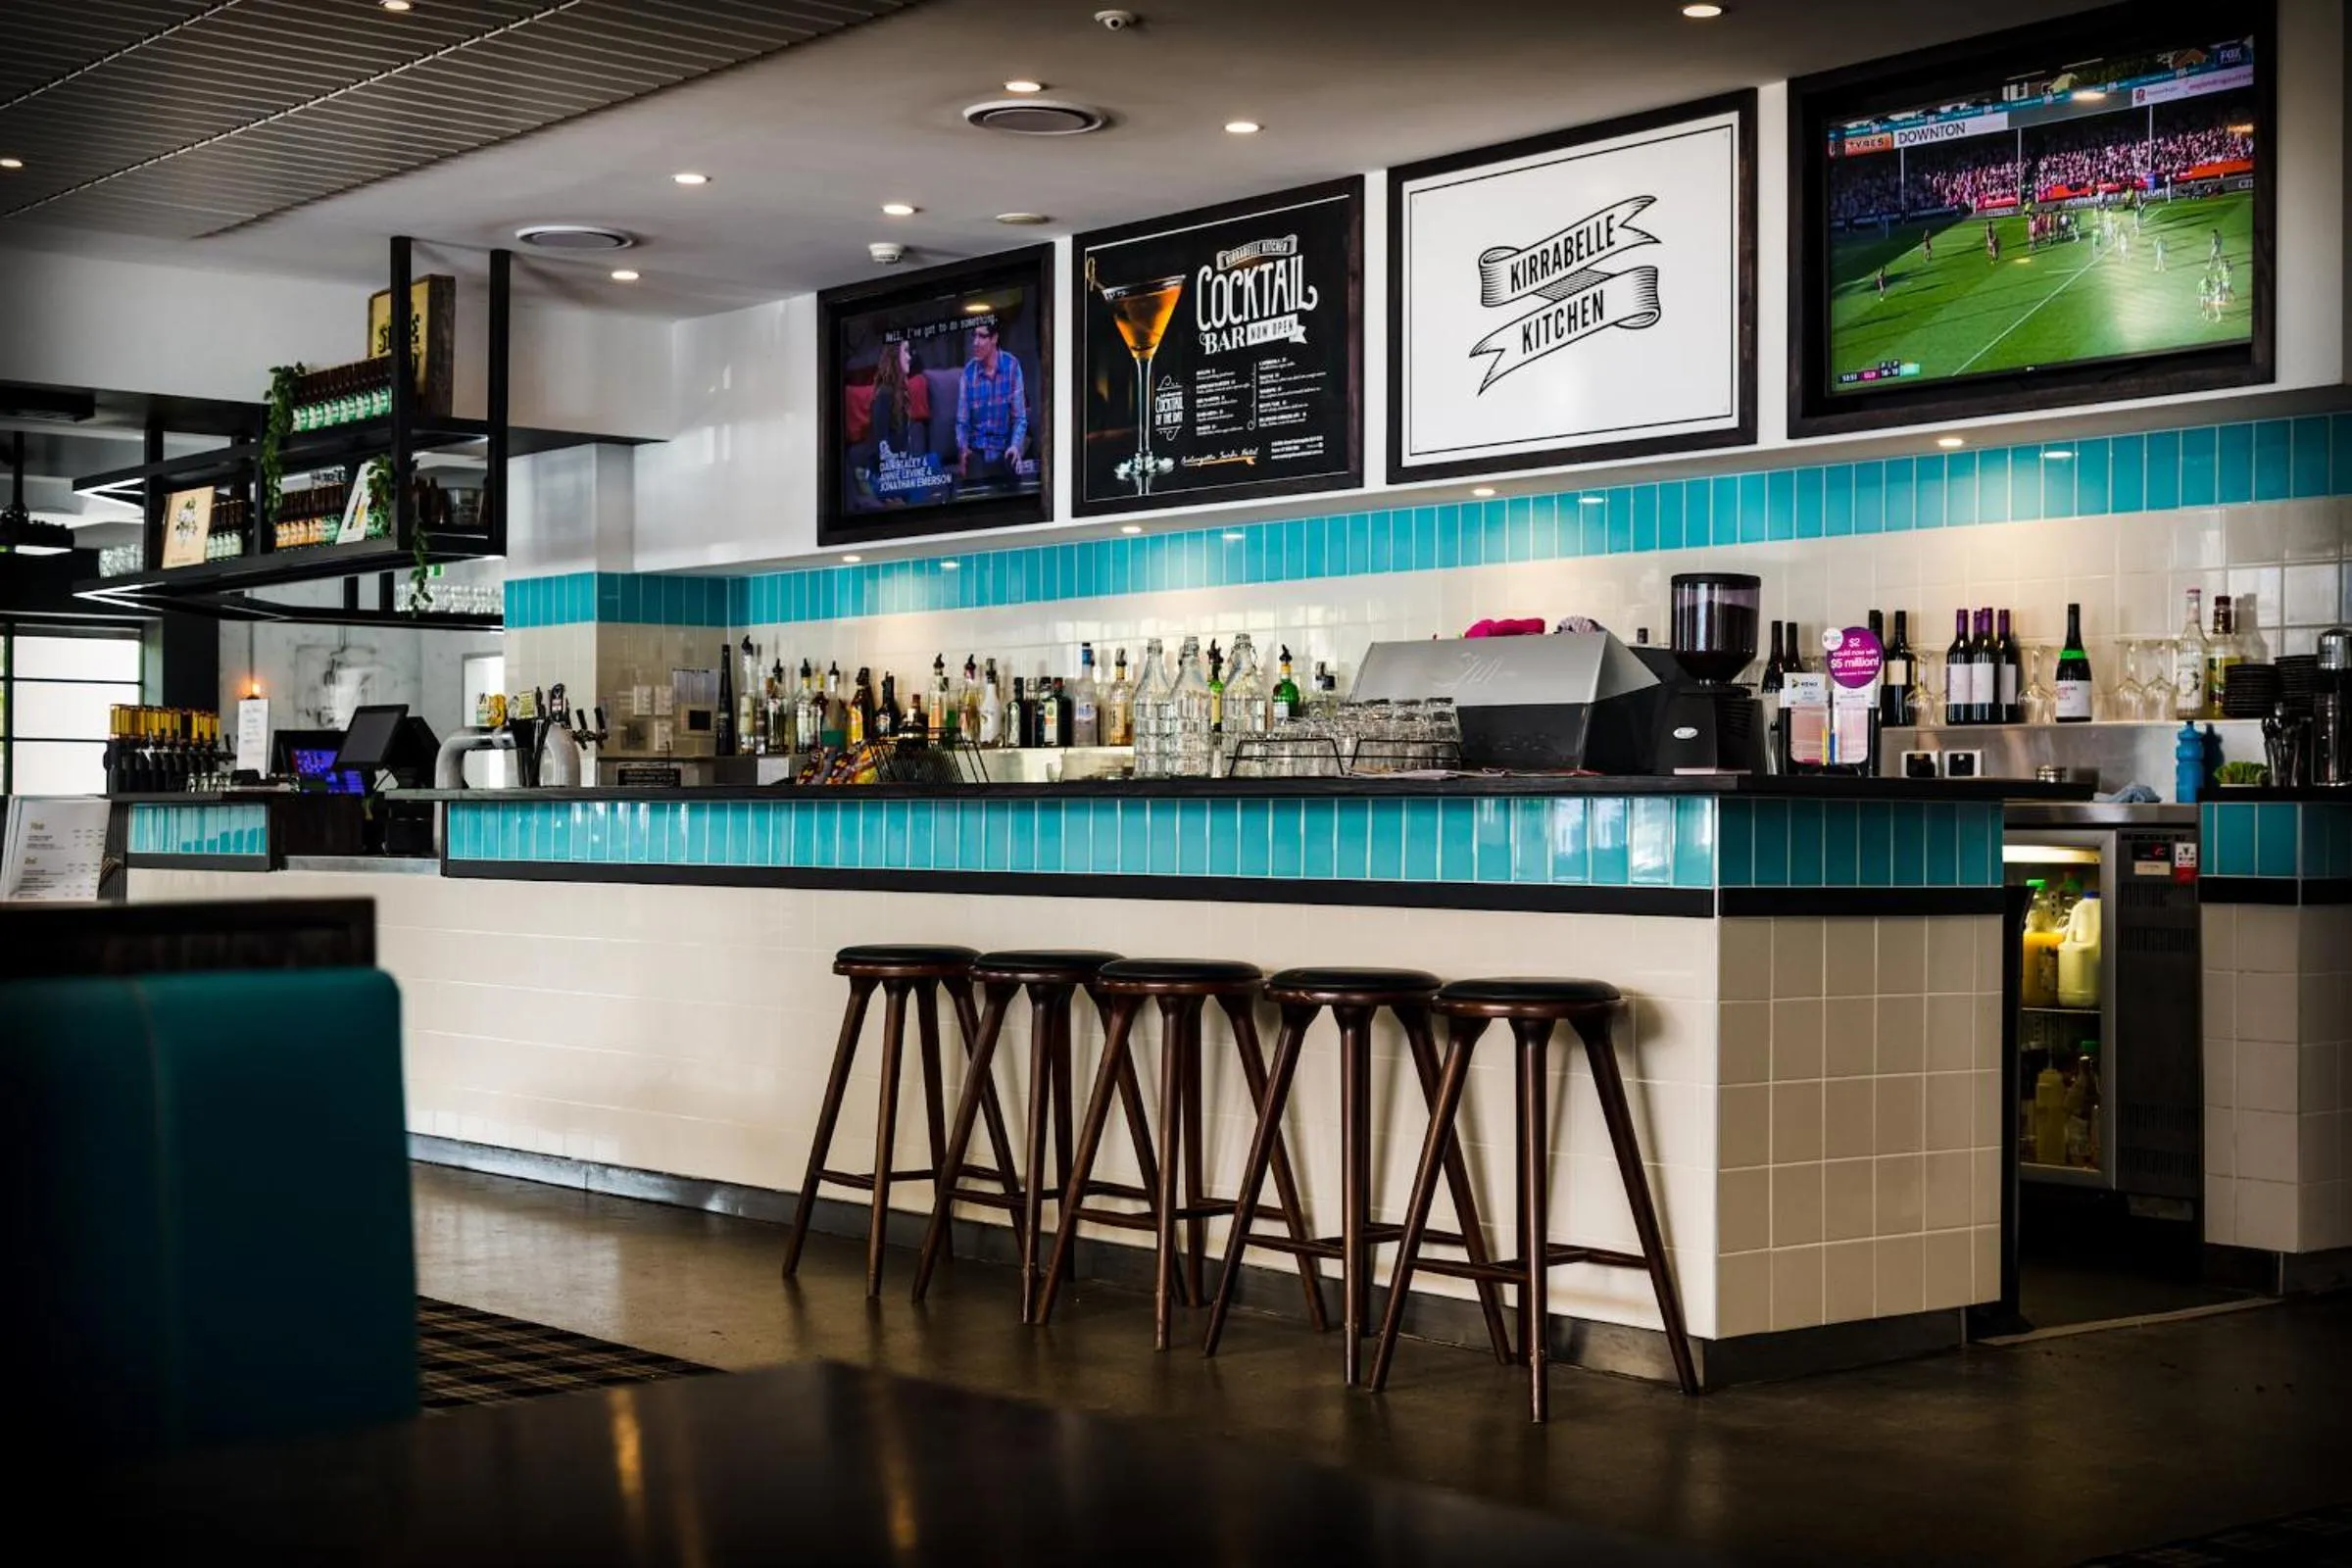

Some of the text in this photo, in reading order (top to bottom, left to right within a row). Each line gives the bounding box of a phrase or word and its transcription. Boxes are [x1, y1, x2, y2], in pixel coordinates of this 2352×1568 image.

[1898, 122, 1966, 145] DOWNTON
[1510, 214, 1616, 293] KIRRABELLE
[1197, 255, 1318, 331] COCKTAIL
[1250, 319, 1294, 340] NOW OPEN
[1522, 289, 1604, 354] KITCHEN
[1199, 325, 1246, 355] BAR
[1848, 637, 1860, 648] $2
[1831, 656, 1880, 668] $5 million!
